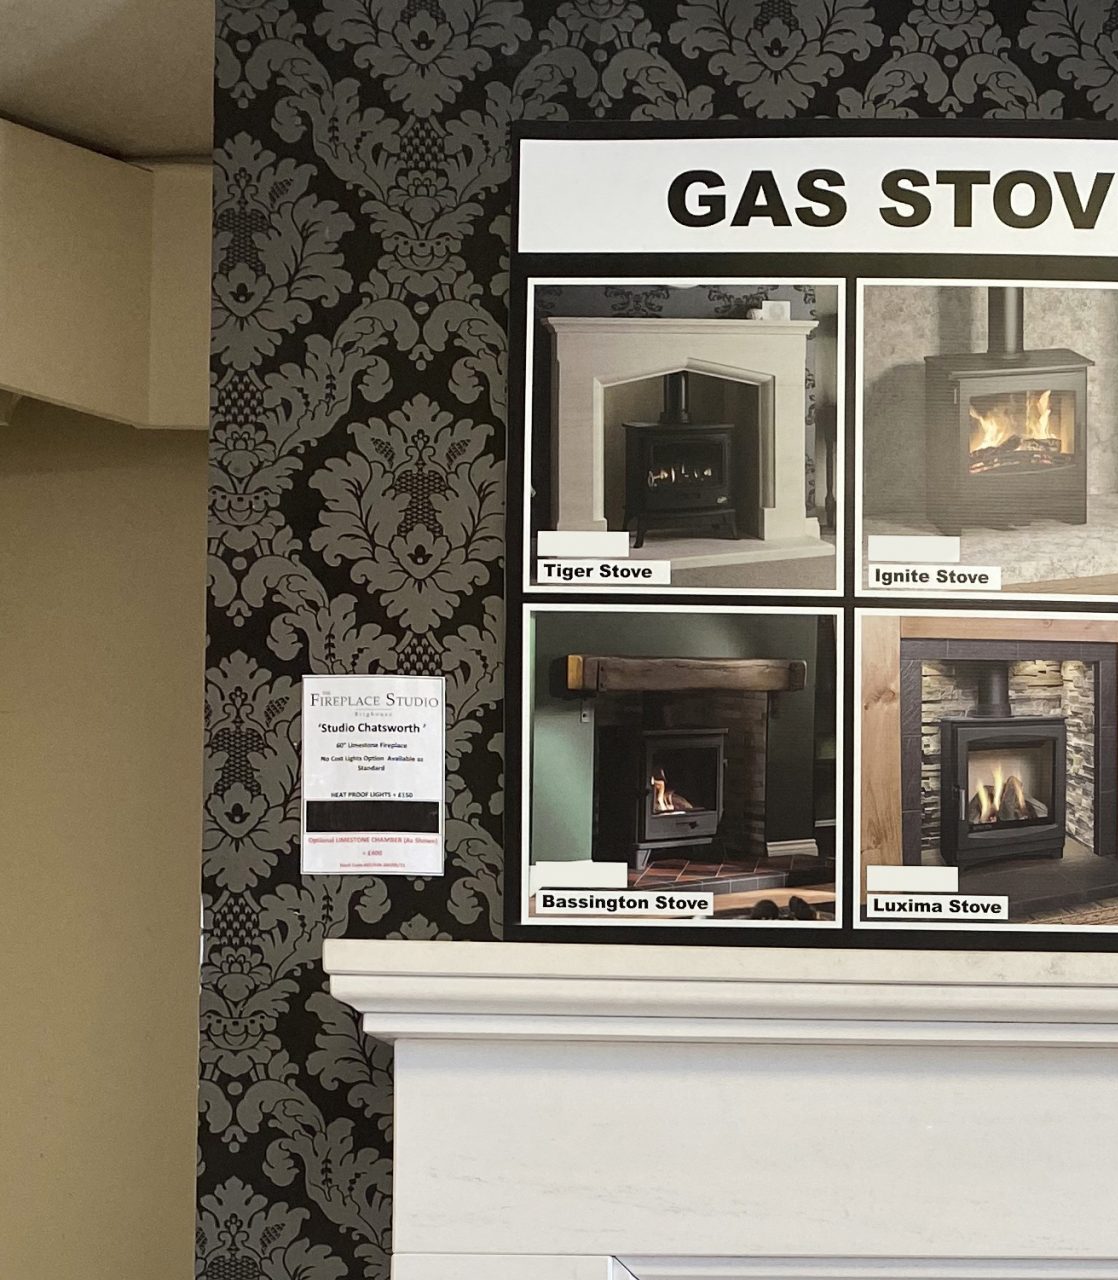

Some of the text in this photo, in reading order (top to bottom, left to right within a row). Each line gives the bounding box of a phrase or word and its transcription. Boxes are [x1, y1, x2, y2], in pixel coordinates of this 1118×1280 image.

[667, 169, 847, 228] GAS
[543, 562, 653, 583] Tiger Stove
[875, 568, 990, 588] Ignite Stove
[310, 692, 439, 708] FIREPLACE STUDIO
[542, 894, 709, 913] Bassington Stove
[873, 898, 1002, 915] Luxima Stove
